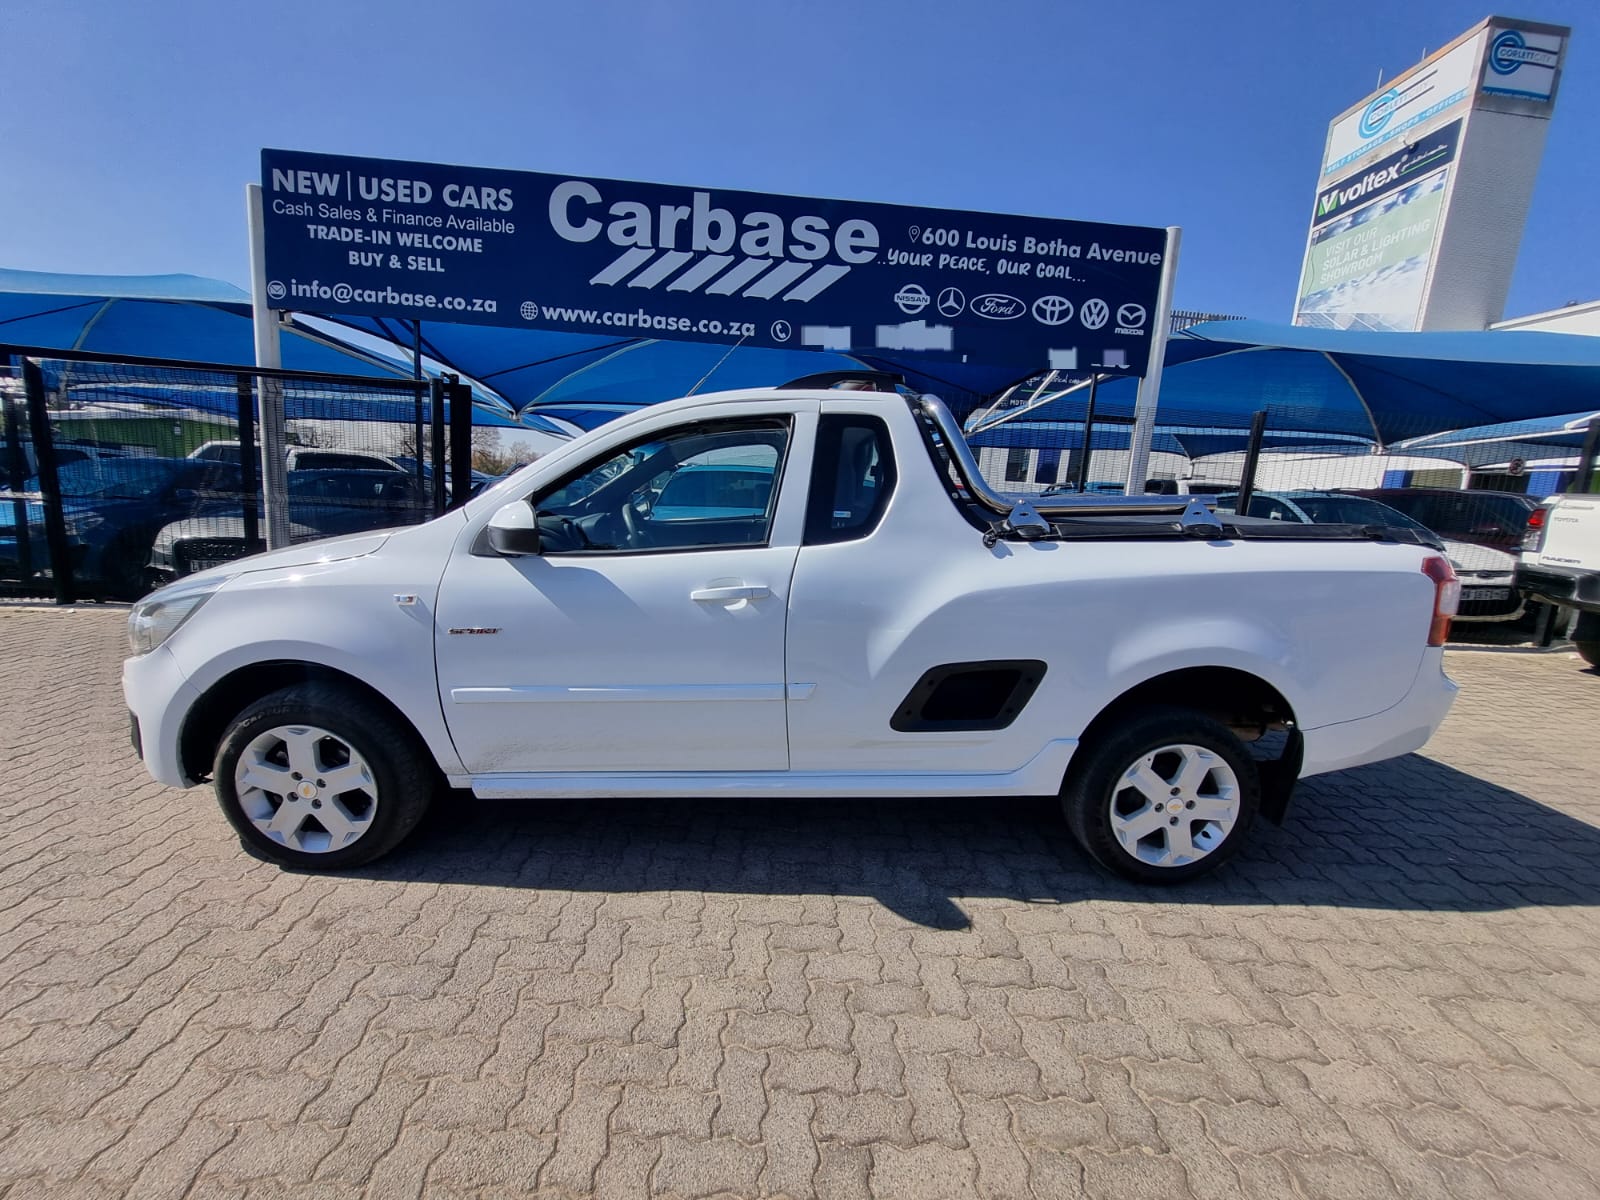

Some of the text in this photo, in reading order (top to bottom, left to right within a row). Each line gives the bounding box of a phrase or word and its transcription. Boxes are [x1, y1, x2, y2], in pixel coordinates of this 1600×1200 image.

[1346, 137, 1384, 162] STORAGE
[272, 168, 514, 212] NEW USED CARS
[1339, 162, 1401, 205] voltex
[272, 200, 515, 234] Cash Sales & Finance Available
[549, 180, 880, 264] Carbase
[307, 224, 483, 253] TRADE-IN WELCOME
[922, 227, 1162, 265] 600 Louis Botha Avenue
[1322, 219, 1431, 271] SOLAR & LIGHTING
[1326, 227, 1378, 257] VISIT OUR
[349, 251, 445, 273] BUY & SELL
[938, 253, 991, 275] PEACE,
[997, 258, 1031, 276] OUR
[1319, 251, 1384, 284] SHOWROOM
[290, 279, 497, 313] info@carbase.co.za
[896, 295, 929, 304] NISSAN
[980, 296, 1015, 315] Ford
[541, 304, 755, 337] www.carbase.co.za
[1114, 327, 1145, 336] mazda
